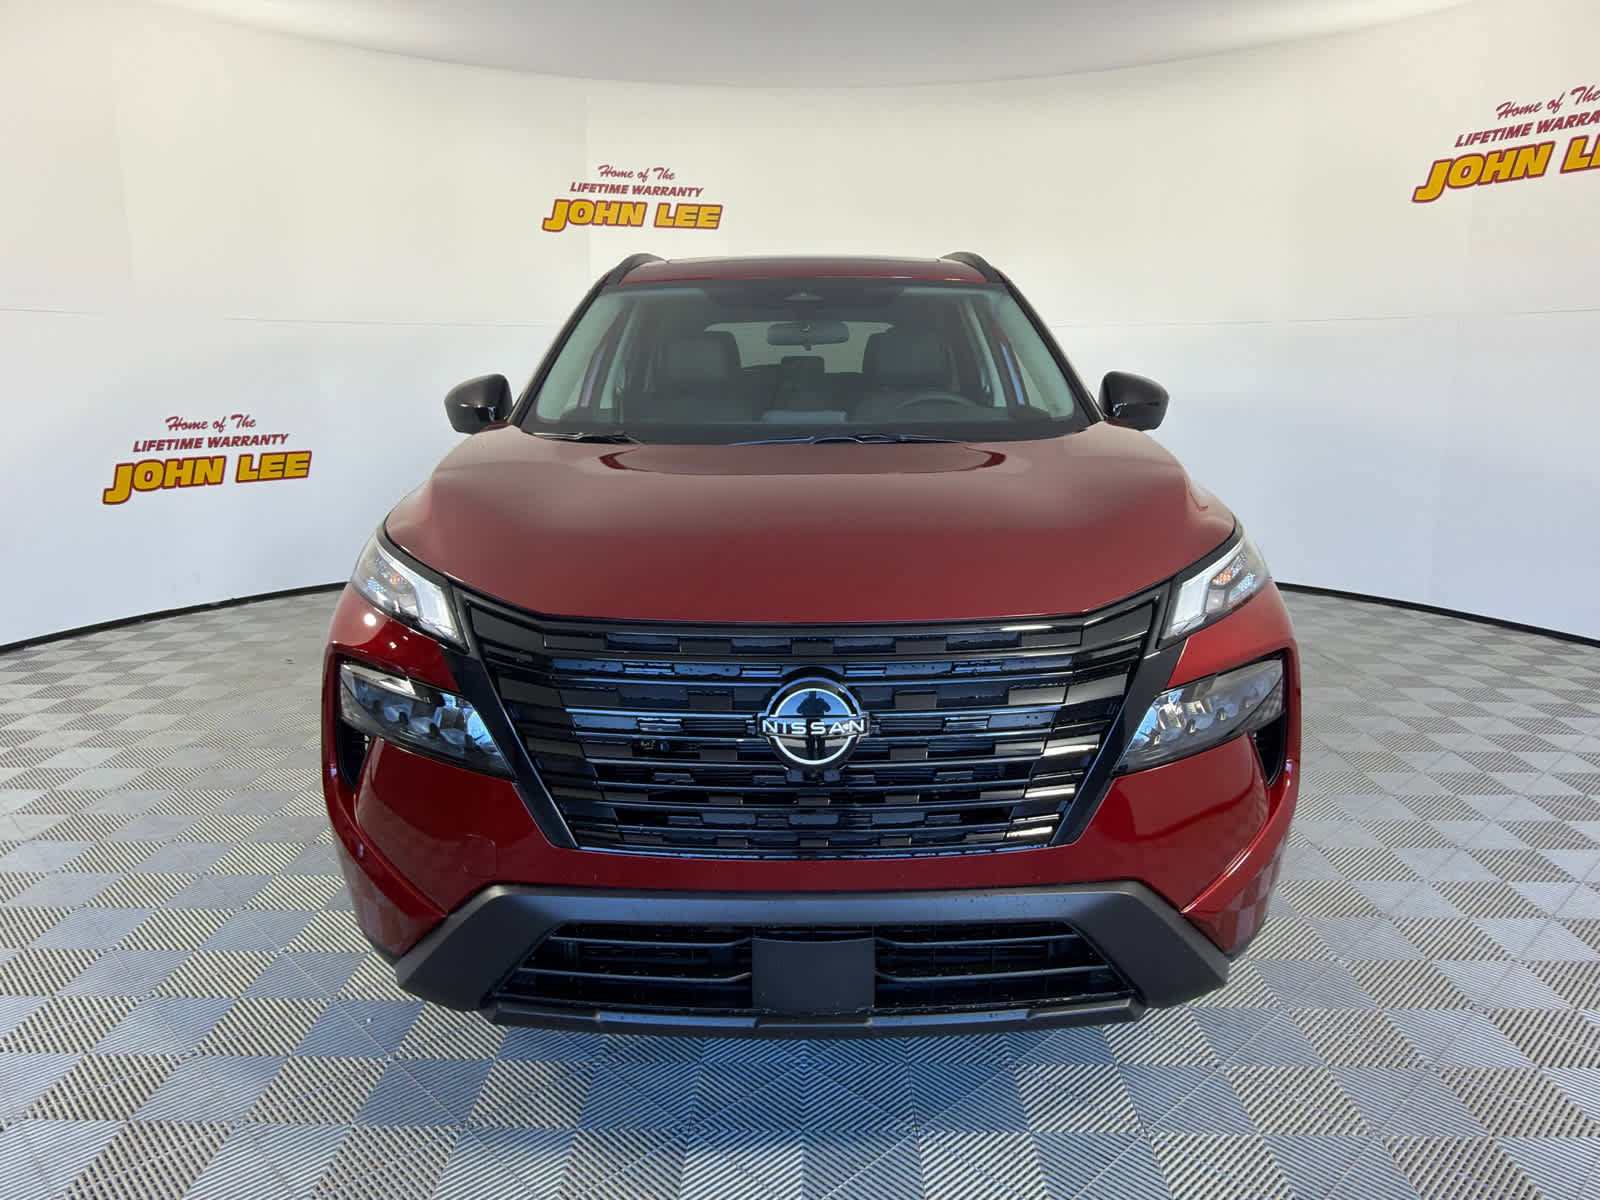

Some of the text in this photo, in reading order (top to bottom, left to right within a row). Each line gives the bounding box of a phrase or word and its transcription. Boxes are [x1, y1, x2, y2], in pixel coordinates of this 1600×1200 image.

[1495, 101, 1542, 120] Home
[1547, 91, 1566, 114] of
[1454, 121, 1534, 148] LIFETIME
[597, 164, 675, 183] Home of The
[1411, 141, 1556, 203] JOHN
[570, 182, 704, 198] LIFETIME WARRANTY
[542, 198, 723, 233] JOHN LEE
[165, 413, 256, 433] Home of The
[132, 433, 289, 453] LIFETIME WARRANTY
[102, 450, 312, 505] JOHN LEE
[762, 719, 865, 735] NISSAN
